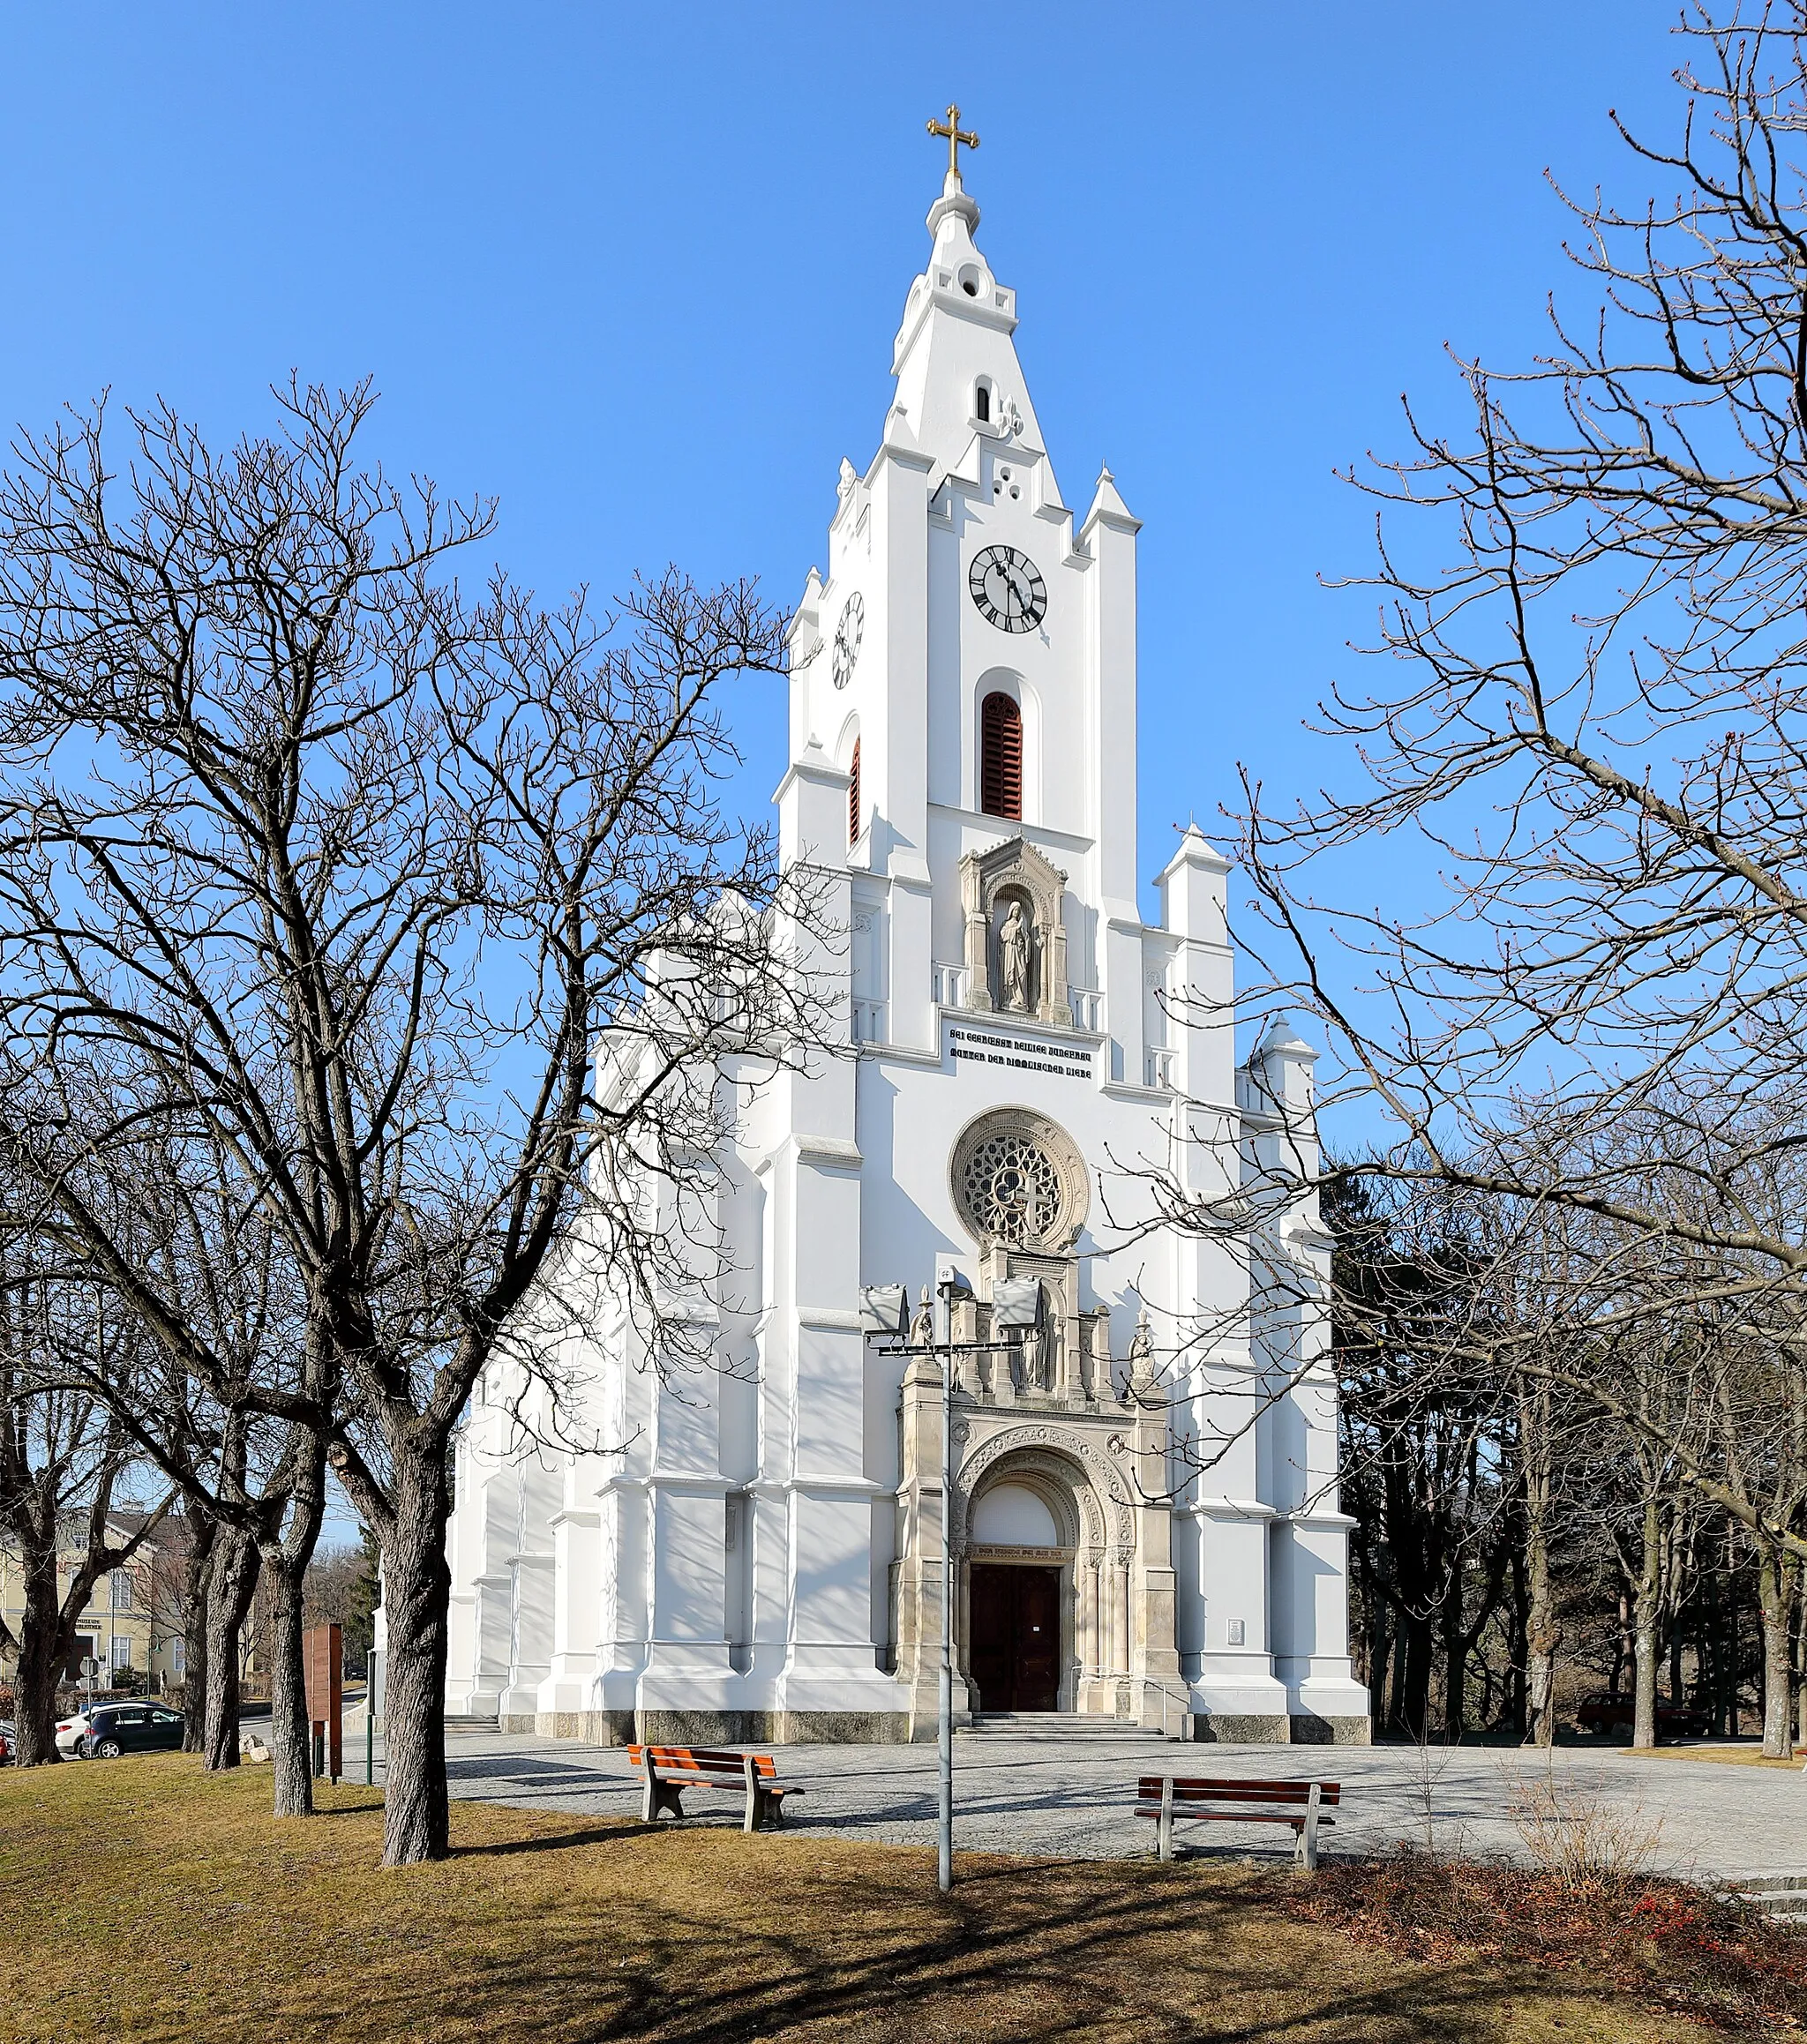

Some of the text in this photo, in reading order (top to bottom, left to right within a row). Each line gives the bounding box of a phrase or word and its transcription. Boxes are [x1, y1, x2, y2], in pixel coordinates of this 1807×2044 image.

[949, 1029, 965, 1041] SEI
[1048, 1046, 1091, 1062] JUNGFRAU
[950, 1047, 1091, 1079] MUTTER DER HIMMLISCHEN LIEBE
